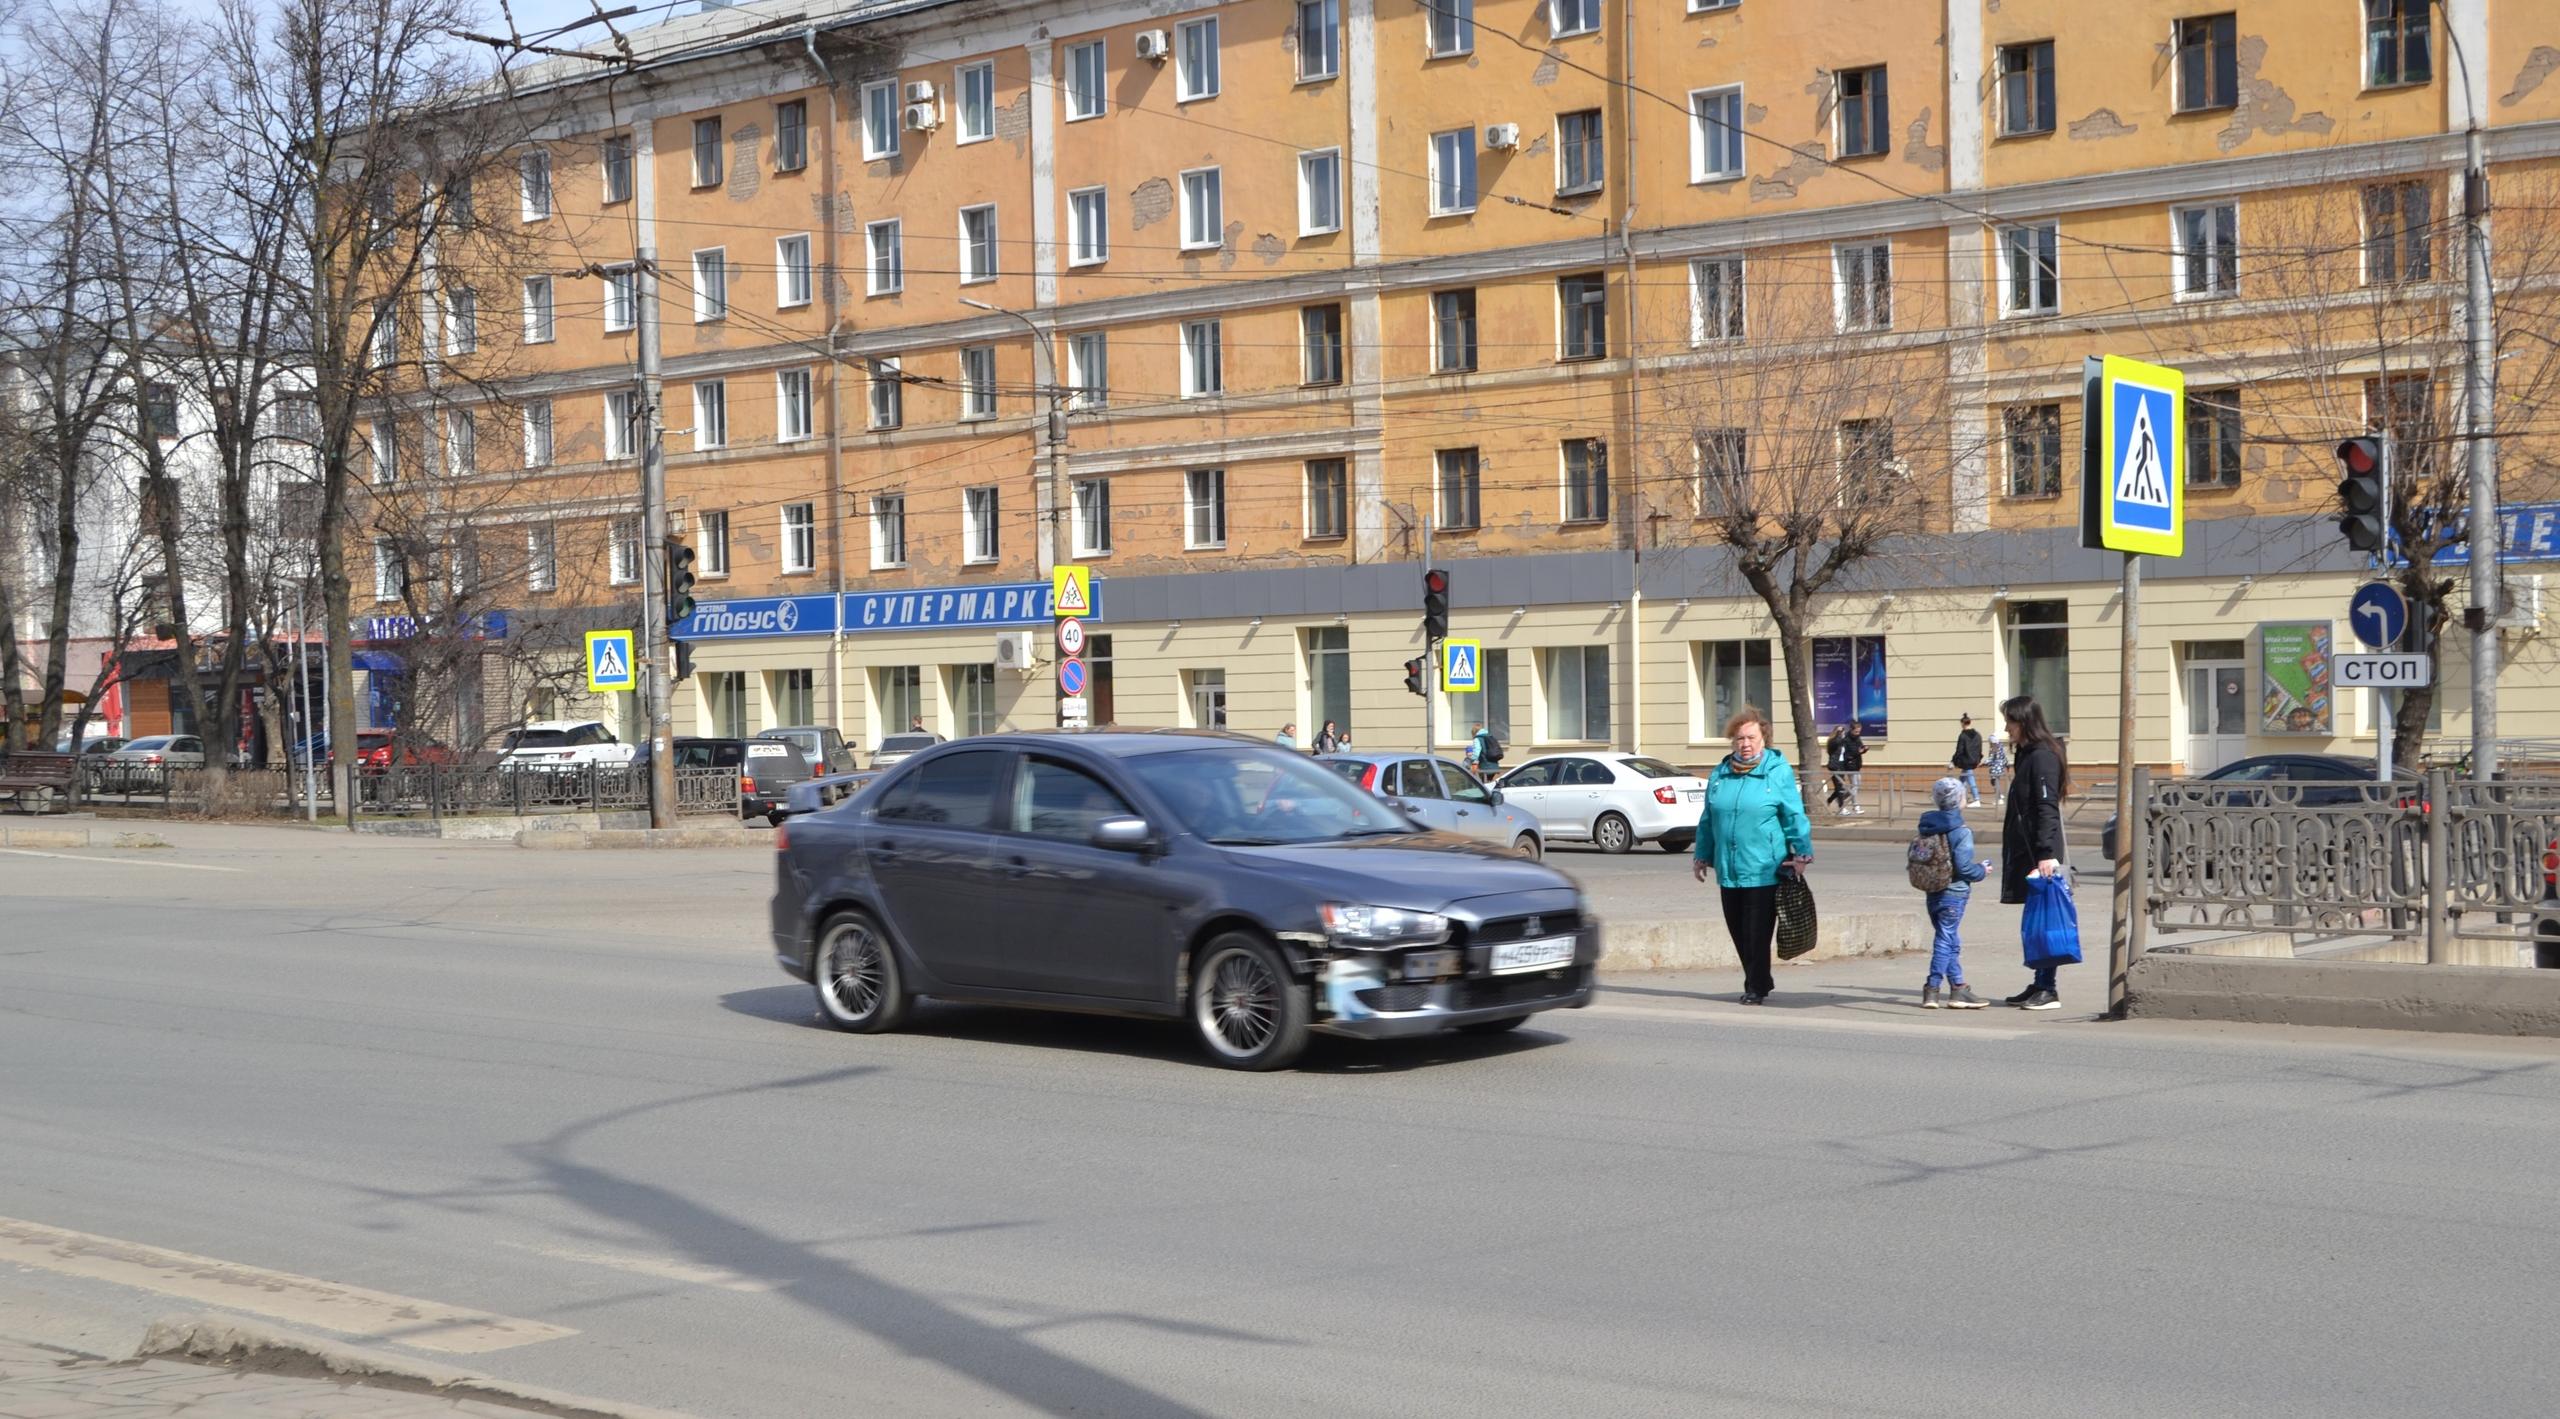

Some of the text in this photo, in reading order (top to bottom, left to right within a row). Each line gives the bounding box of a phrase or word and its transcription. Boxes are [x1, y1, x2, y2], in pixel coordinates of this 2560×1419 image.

[863, 590, 1055, 625] СУПЕРМАРКЕ
[368, 616, 428, 641] АПТЕК
[693, 611, 777, 632] ГЛОБУС
[1065, 629, 1079, 643] 40
[2345, 661, 2416, 680] СТОП
